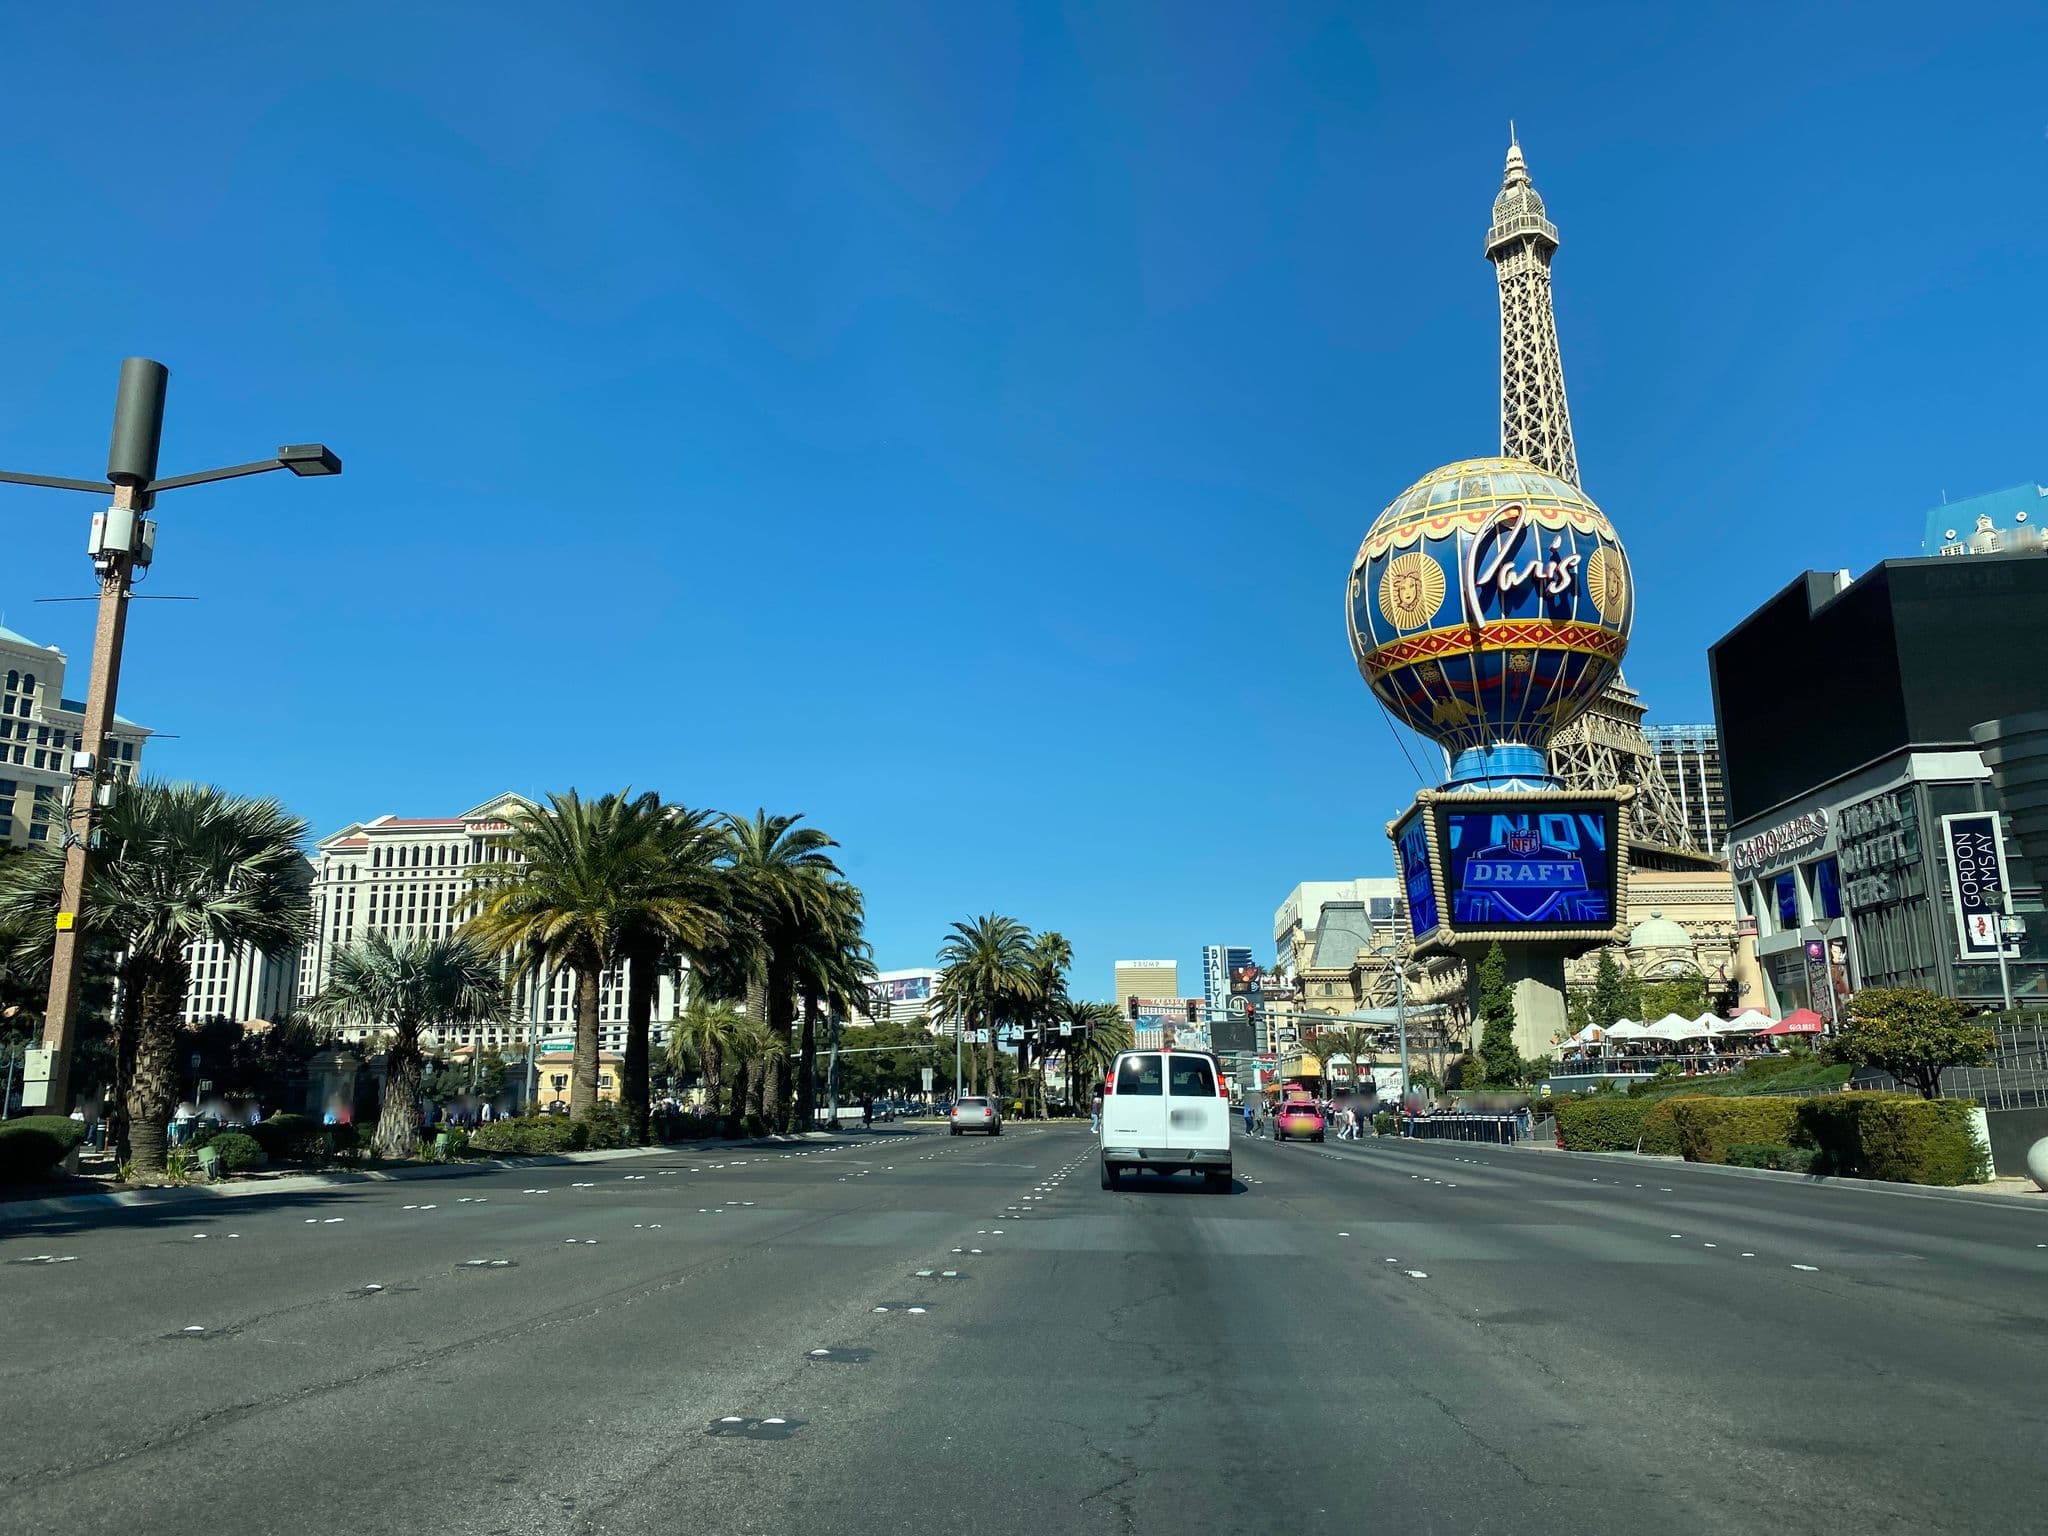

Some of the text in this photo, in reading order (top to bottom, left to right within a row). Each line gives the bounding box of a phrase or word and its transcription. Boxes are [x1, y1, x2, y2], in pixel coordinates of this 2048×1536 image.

[1465, 501, 1582, 629] Paris
[1512, 838, 1536, 853] NFL
[1735, 817, 1812, 869] CABO WABO
[1473, 865, 1575, 881] DRAFT
[1954, 833, 1981, 907] GORDON
[1975, 832, 2000, 907] RAMSAY
[868, 983, 894, 999] LOVE
[1152, 998, 1187, 1007] TREASUR
